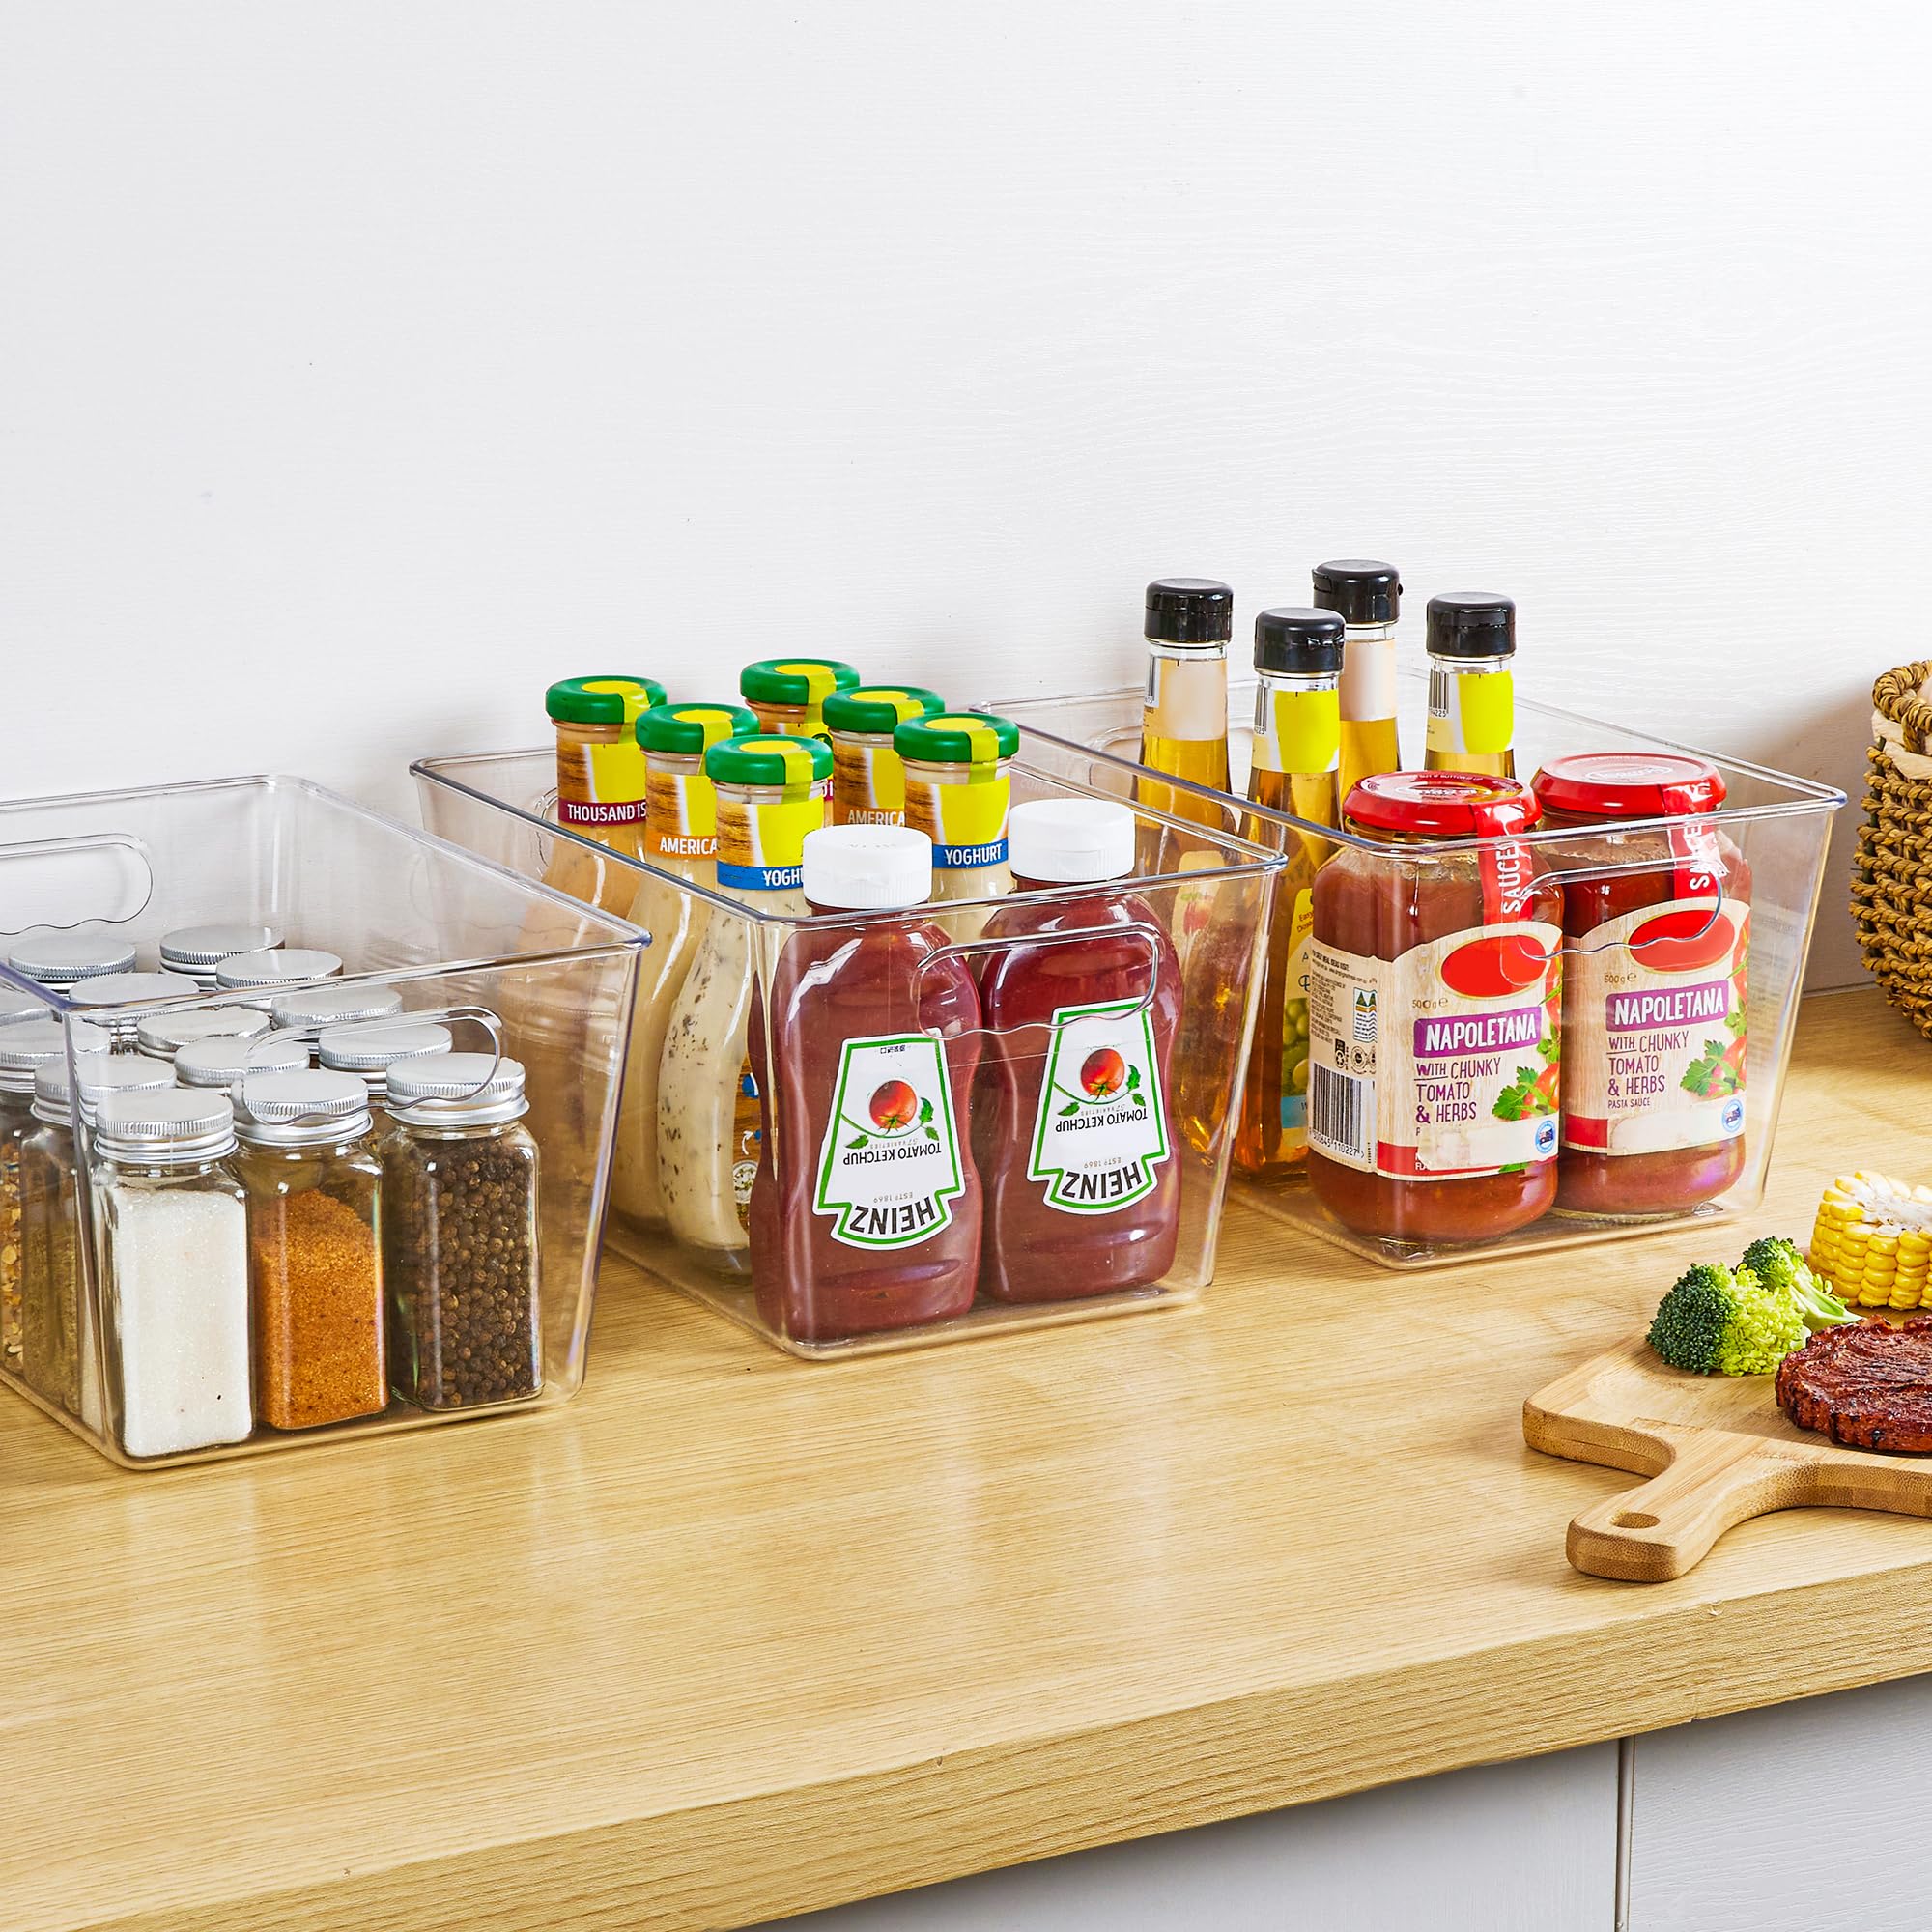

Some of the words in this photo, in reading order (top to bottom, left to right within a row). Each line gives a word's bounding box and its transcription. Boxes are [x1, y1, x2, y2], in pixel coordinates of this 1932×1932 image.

[567, 804, 635, 821] THOUSAND
[637, 802, 647, 818] IS
[848, 810, 906, 828] AMERICA
[660, 837, 718, 855] AMERICA
[944, 842, 1003, 865] YOGHURT
[763, 868, 804, 887] YOGH
[1495, 843, 1520, 914] SAUCE
[1614, 987, 1724, 1025] NAPOLETANA
[1425, 1014, 1536, 1052] NAPOLETANA
[1608, 1037, 1634, 1051] WITH
[1639, 1031, 1690, 1052] CHUNKY
[1416, 1062, 1446, 1077] WITH
[1451, 1057, 1501, 1078] CHUNKY
[1608, 1056, 1660, 1076] TOMATO
[1416, 1082, 1470, 1102] TOMATO
[1608, 1078, 1620, 1096] &
[1626, 1075, 1665, 1095] HERBS
[1416, 1105, 1431, 1124] &
[1436, 1102, 1477, 1123] HERBS
[1608, 1099, 1628, 1109] PASTA
[1630, 1097, 1650, 1108] SAUCE
[1055, 1115, 1104, 1133] KETCHUP
[1106, 1108, 1148, 1125] TOMATO
[843, 1147, 894, 1166] KETCHUP
[897, 1142, 942, 1160] TOMATO
[1083, 1159, 1102, 1169] 1869
[1062, 1161, 1142, 1200] HEINZ
[872, 1193, 893, 1204] 1869
[849, 1196, 936, 1235] HEINZ
